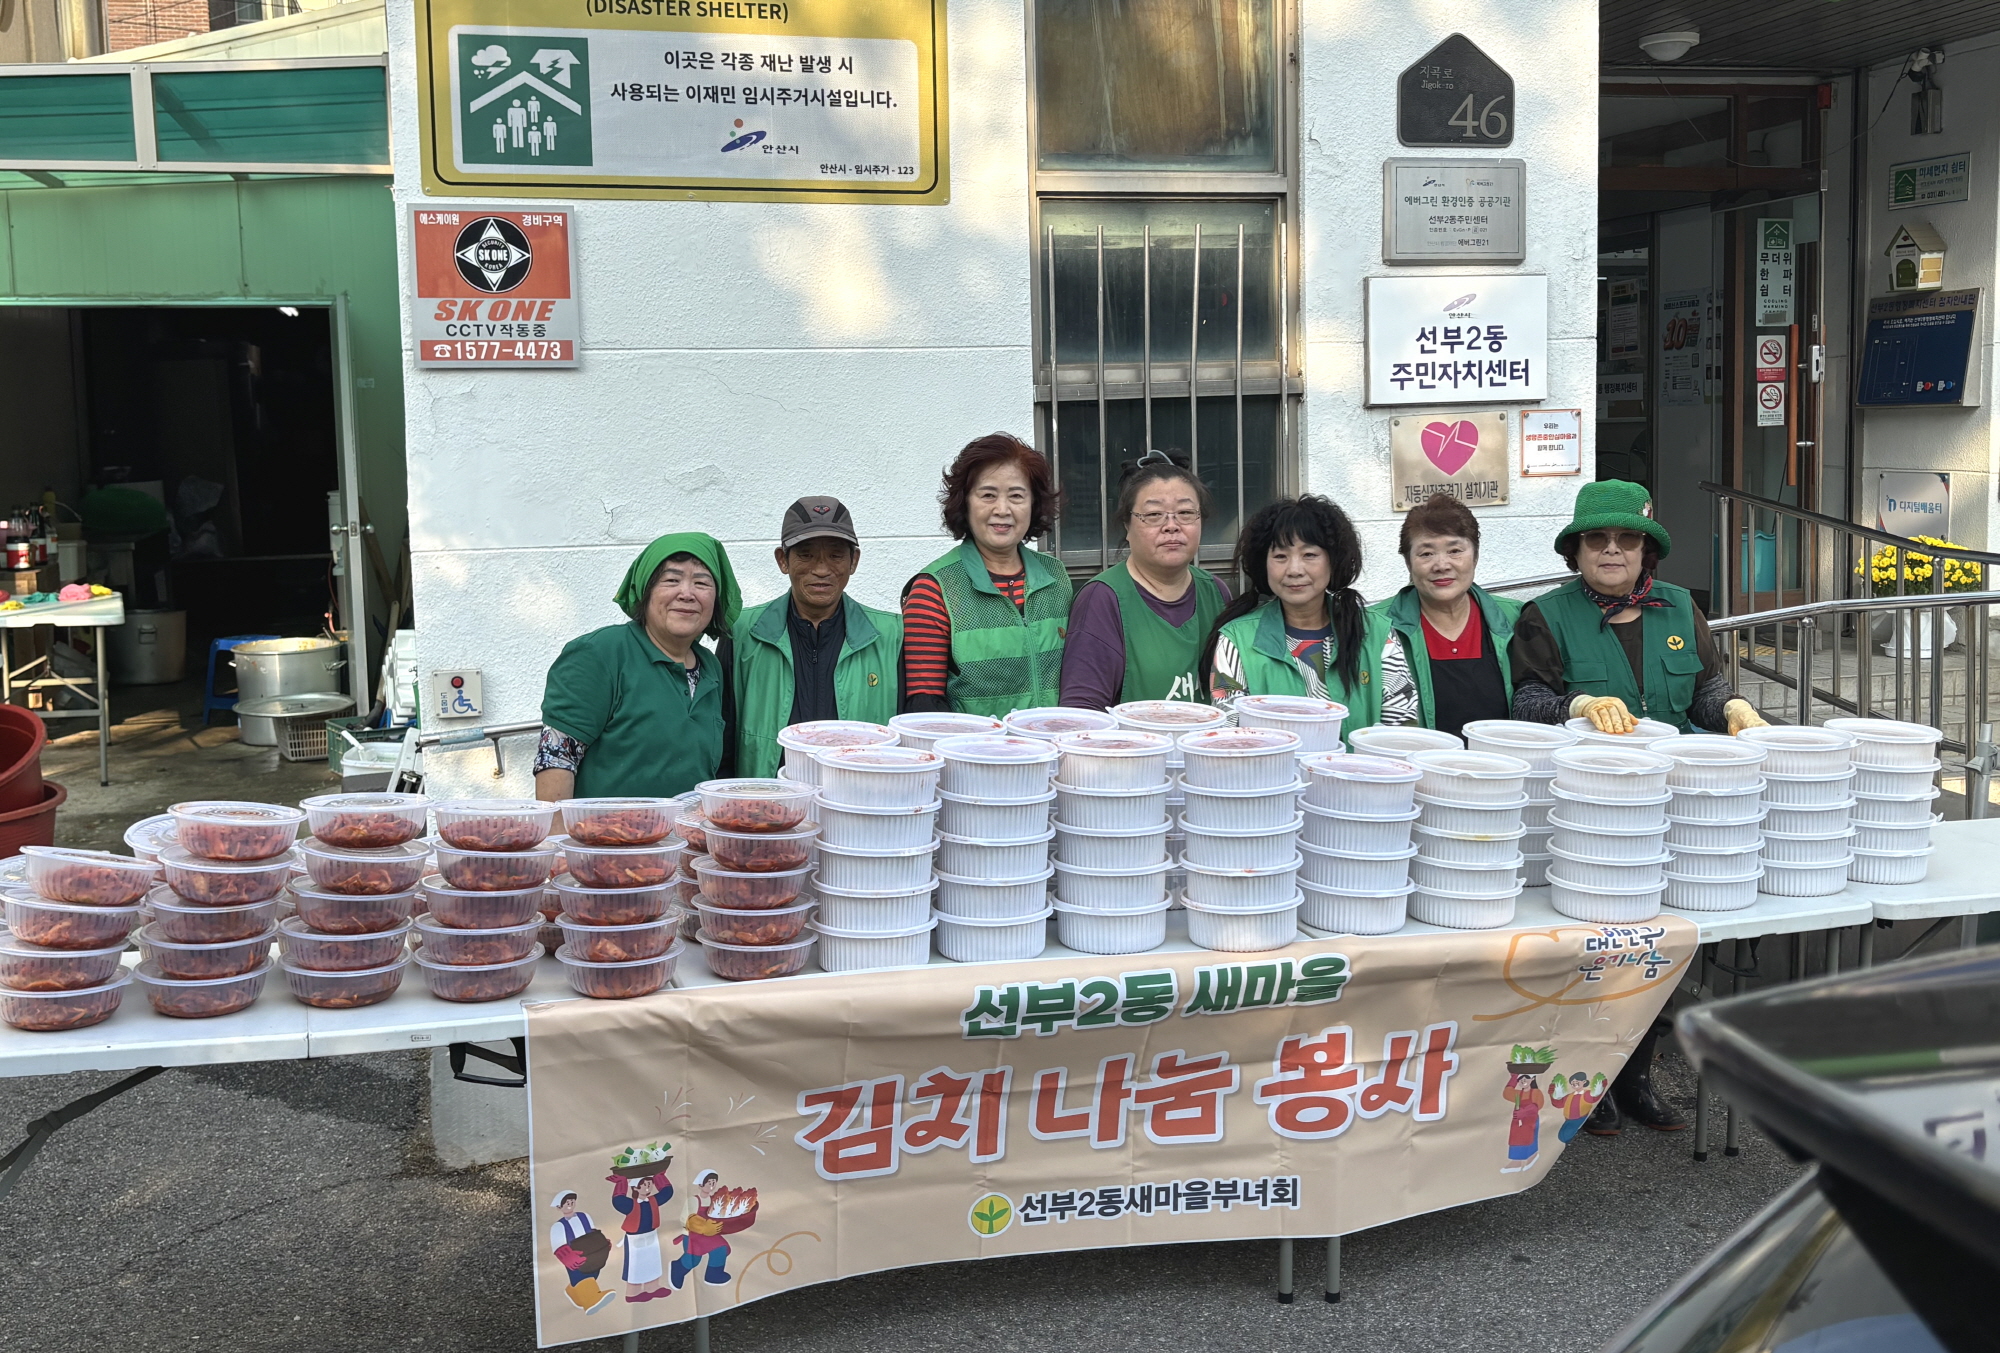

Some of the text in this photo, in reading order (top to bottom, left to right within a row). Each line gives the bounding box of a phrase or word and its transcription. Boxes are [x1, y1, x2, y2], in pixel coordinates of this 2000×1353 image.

[587, 0, 788, 23] (DISASTER SHELTER)
[664, 50, 853, 74] 이곳은 각종 재난 발생 시
[1420, 65, 1454, 79] 지곡로
[1421, 80, 1454, 90] Jigok-ro
[610, 83, 898, 109] 사용되는 이재민 임시주거시설입니다.
[1448, 93, 1507, 138] 46
[761, 144, 799, 155] 안산시
[820, 163, 847, 175] 안산시
[854, 164, 889, 176] 임시주거
[897, 166, 914, 176] 123
[1919, 163, 1949, 178] 미세먼지
[1404, 196, 1511, 208] 에버그린 환경인증 공공기관
[419, 213, 460, 225] 에스케이원
[522, 215, 563, 227] 경비구역
[1428, 215, 1488, 225] 선부2동주민센터
[481, 240, 505, 248] SECURITY
[1458, 239, 1489, 247] 에버그린21
[478, 249, 508, 261] SK ONE
[1760, 252, 1791, 265] 무더위
[484, 262, 504, 270] KOREA
[434, 300, 556, 321] SK ONE
[1416, 325, 1507, 354] 선부2동
[454, 341, 561, 360] 1577-4473
[1390, 359, 1529, 391] 주민자치센터
[1604, 382, 1638, 394] 행정복지센터
[1465, 480, 1499, 500] 설치기관
[1899, 501, 1942, 514] 디지털배움터
[1586, 927, 1665, 951] 대한민국
[1578, 950, 1671, 981] 온기나눔
[964, 956, 1348, 1038] 선부2동 새마을
[803, 1026, 1453, 1174] 김치 나눔 봉사
[1018, 1178, 1299, 1223] 선부2동새마을부녀회
